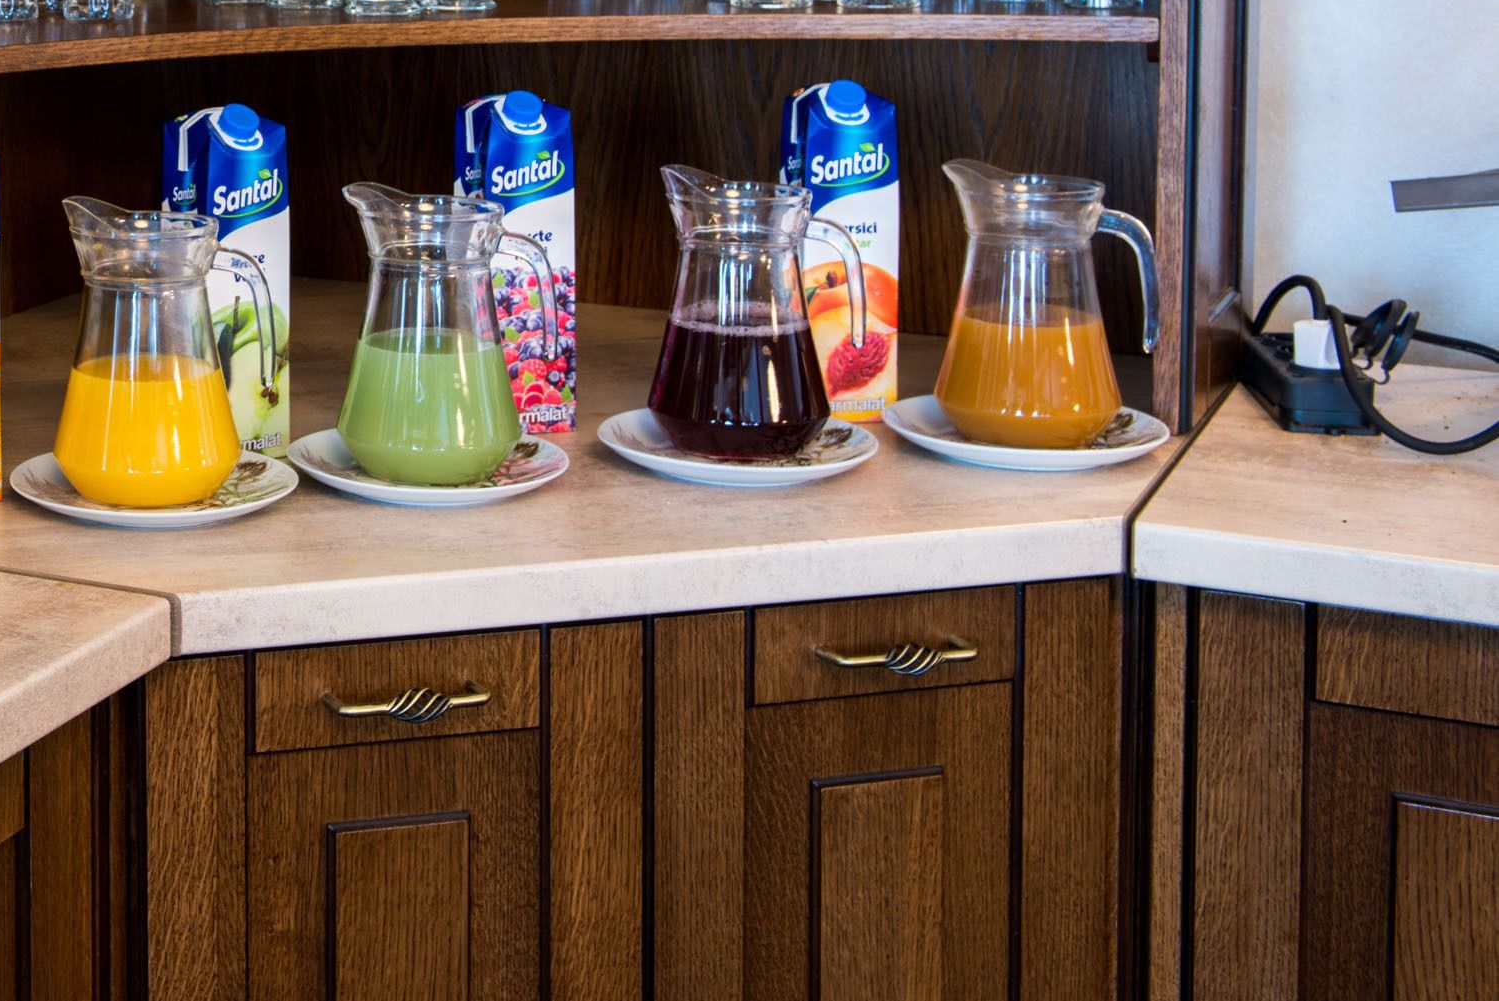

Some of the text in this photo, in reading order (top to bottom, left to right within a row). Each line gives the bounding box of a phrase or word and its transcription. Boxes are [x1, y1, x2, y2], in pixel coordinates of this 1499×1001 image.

[830, 396, 886, 412] armalat
[519, 407, 567, 424] rmalat
[242, 431, 281, 451] malat
